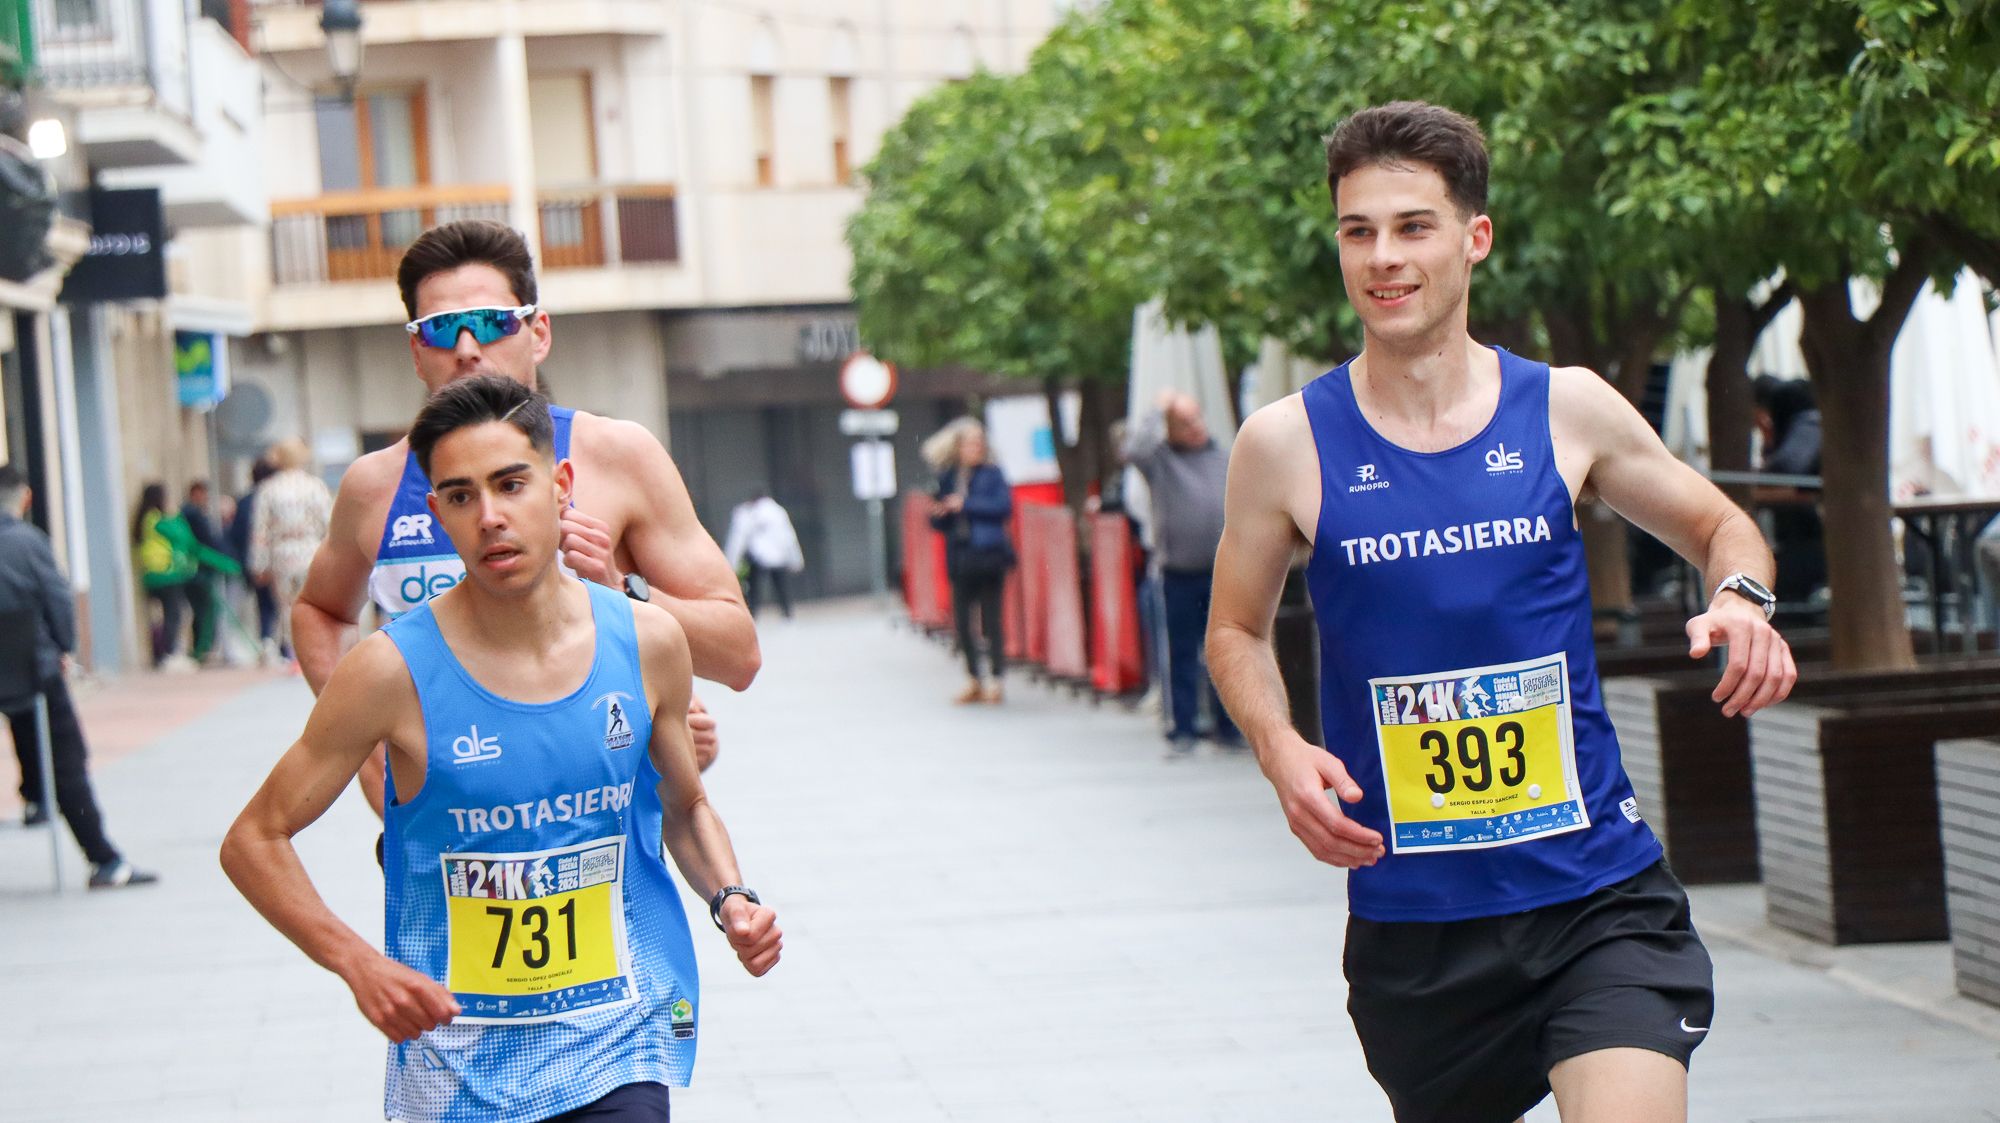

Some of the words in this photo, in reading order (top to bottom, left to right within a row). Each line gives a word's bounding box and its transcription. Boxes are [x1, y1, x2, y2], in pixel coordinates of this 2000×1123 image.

[1485, 443, 1524, 472] als
[1340, 515, 1552, 566] TROTASIERRA
[400, 565, 468, 604] de
[1523, 673, 1553, 686] carreras
[1524, 678, 1558, 695] populares
[1397, 681, 1461, 725] 21K
[452, 725, 502, 764] als
[1420, 721, 1526, 794] 393
[448, 776, 636, 833] TROTASIERR
[468, 860, 528, 900] 21K
[486, 898, 577, 969] 731
